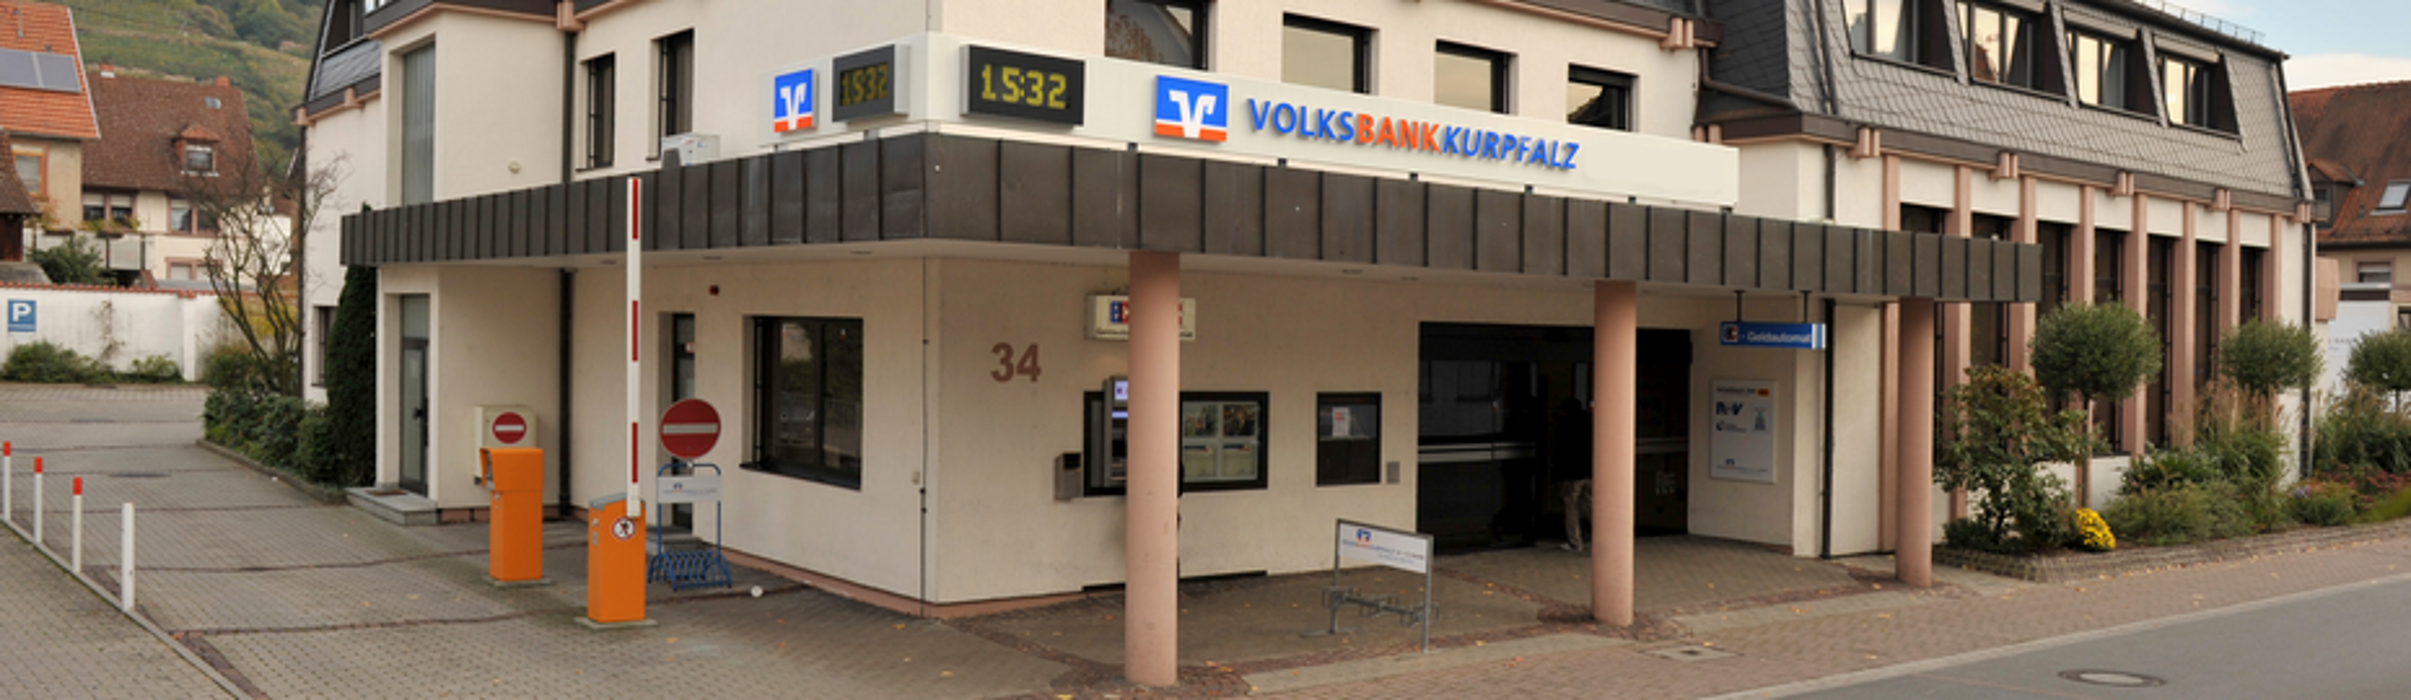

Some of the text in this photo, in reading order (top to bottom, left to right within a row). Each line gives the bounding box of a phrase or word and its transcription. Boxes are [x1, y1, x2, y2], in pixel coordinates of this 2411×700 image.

[981, 63, 1067, 110] 15:32
[1247, 98, 1580, 169] VOLKSBANKKURPFALZ
[12, 303, 31, 322] P
[990, 342, 1042, 382] 34
